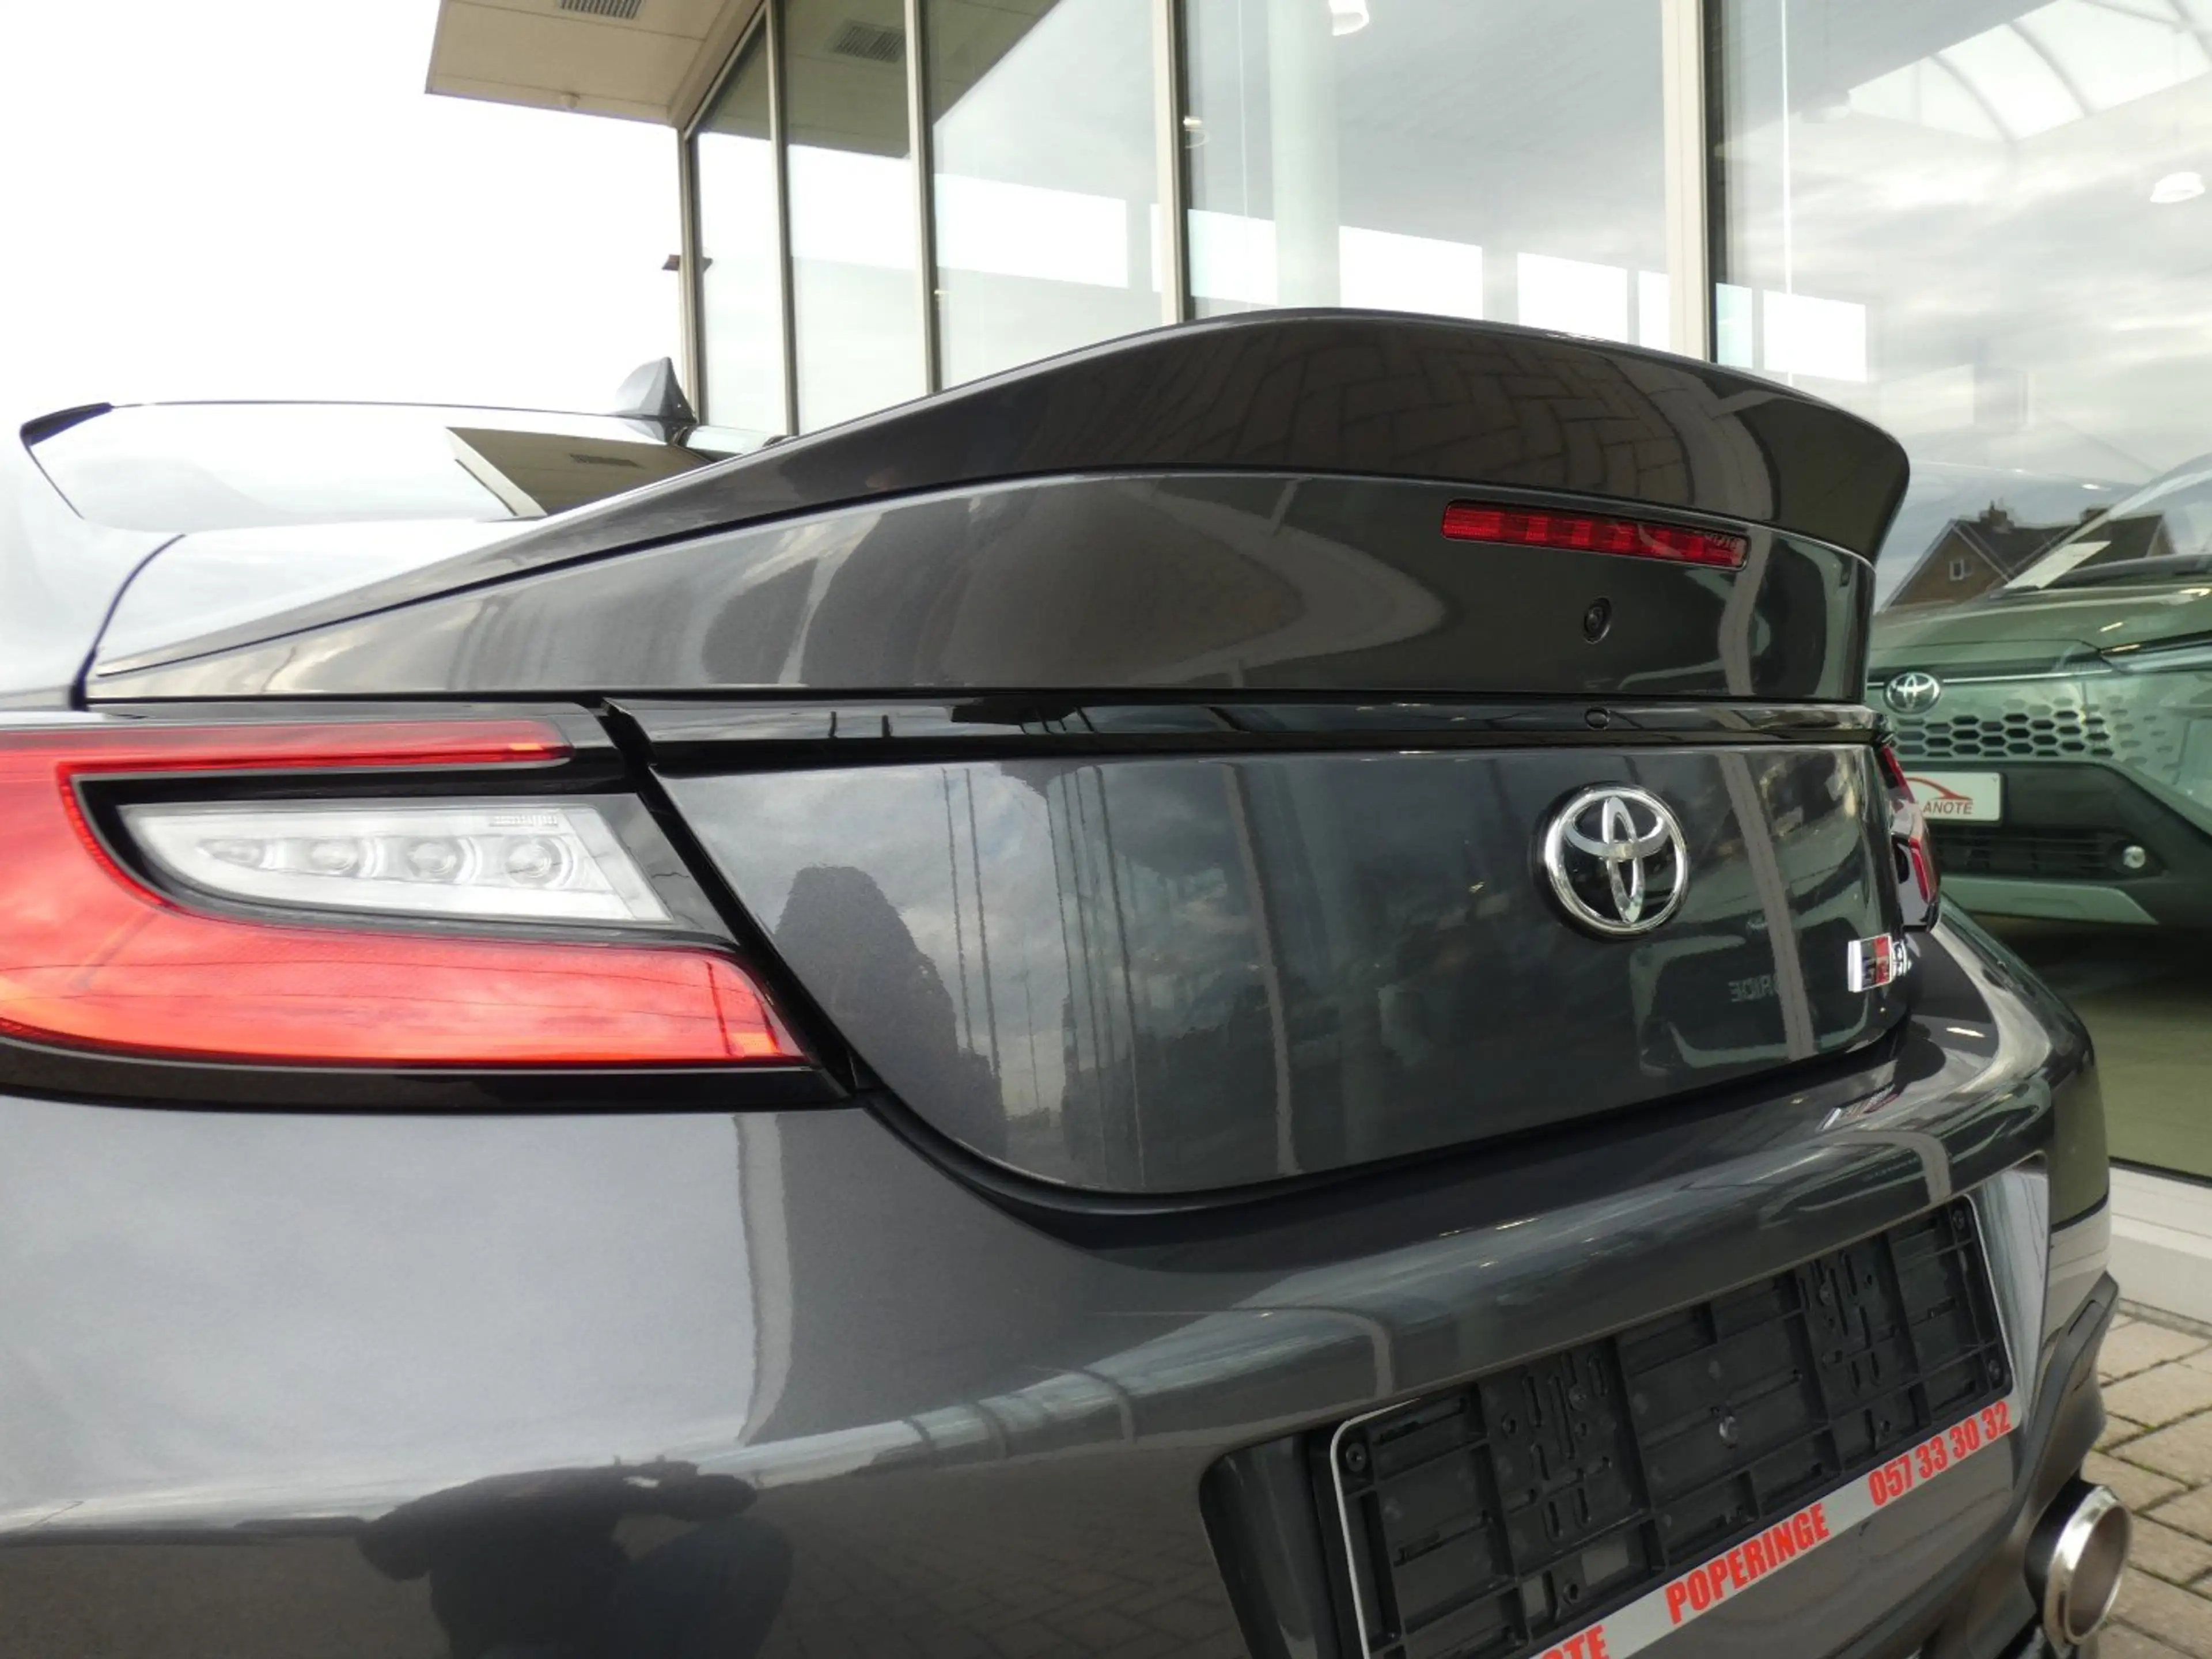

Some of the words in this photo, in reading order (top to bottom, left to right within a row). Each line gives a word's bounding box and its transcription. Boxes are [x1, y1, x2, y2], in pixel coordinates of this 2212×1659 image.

[1916, 800, 1974, 815] ANOTE
[1665, 1502, 1830, 1624] POPERINGE
[1868, 1454, 1913, 1506] 057
[1915, 1436, 1948, 1478] 33
[1949, 1418, 1979, 1459] 30
[1982, 1400, 2010, 1440] 32
